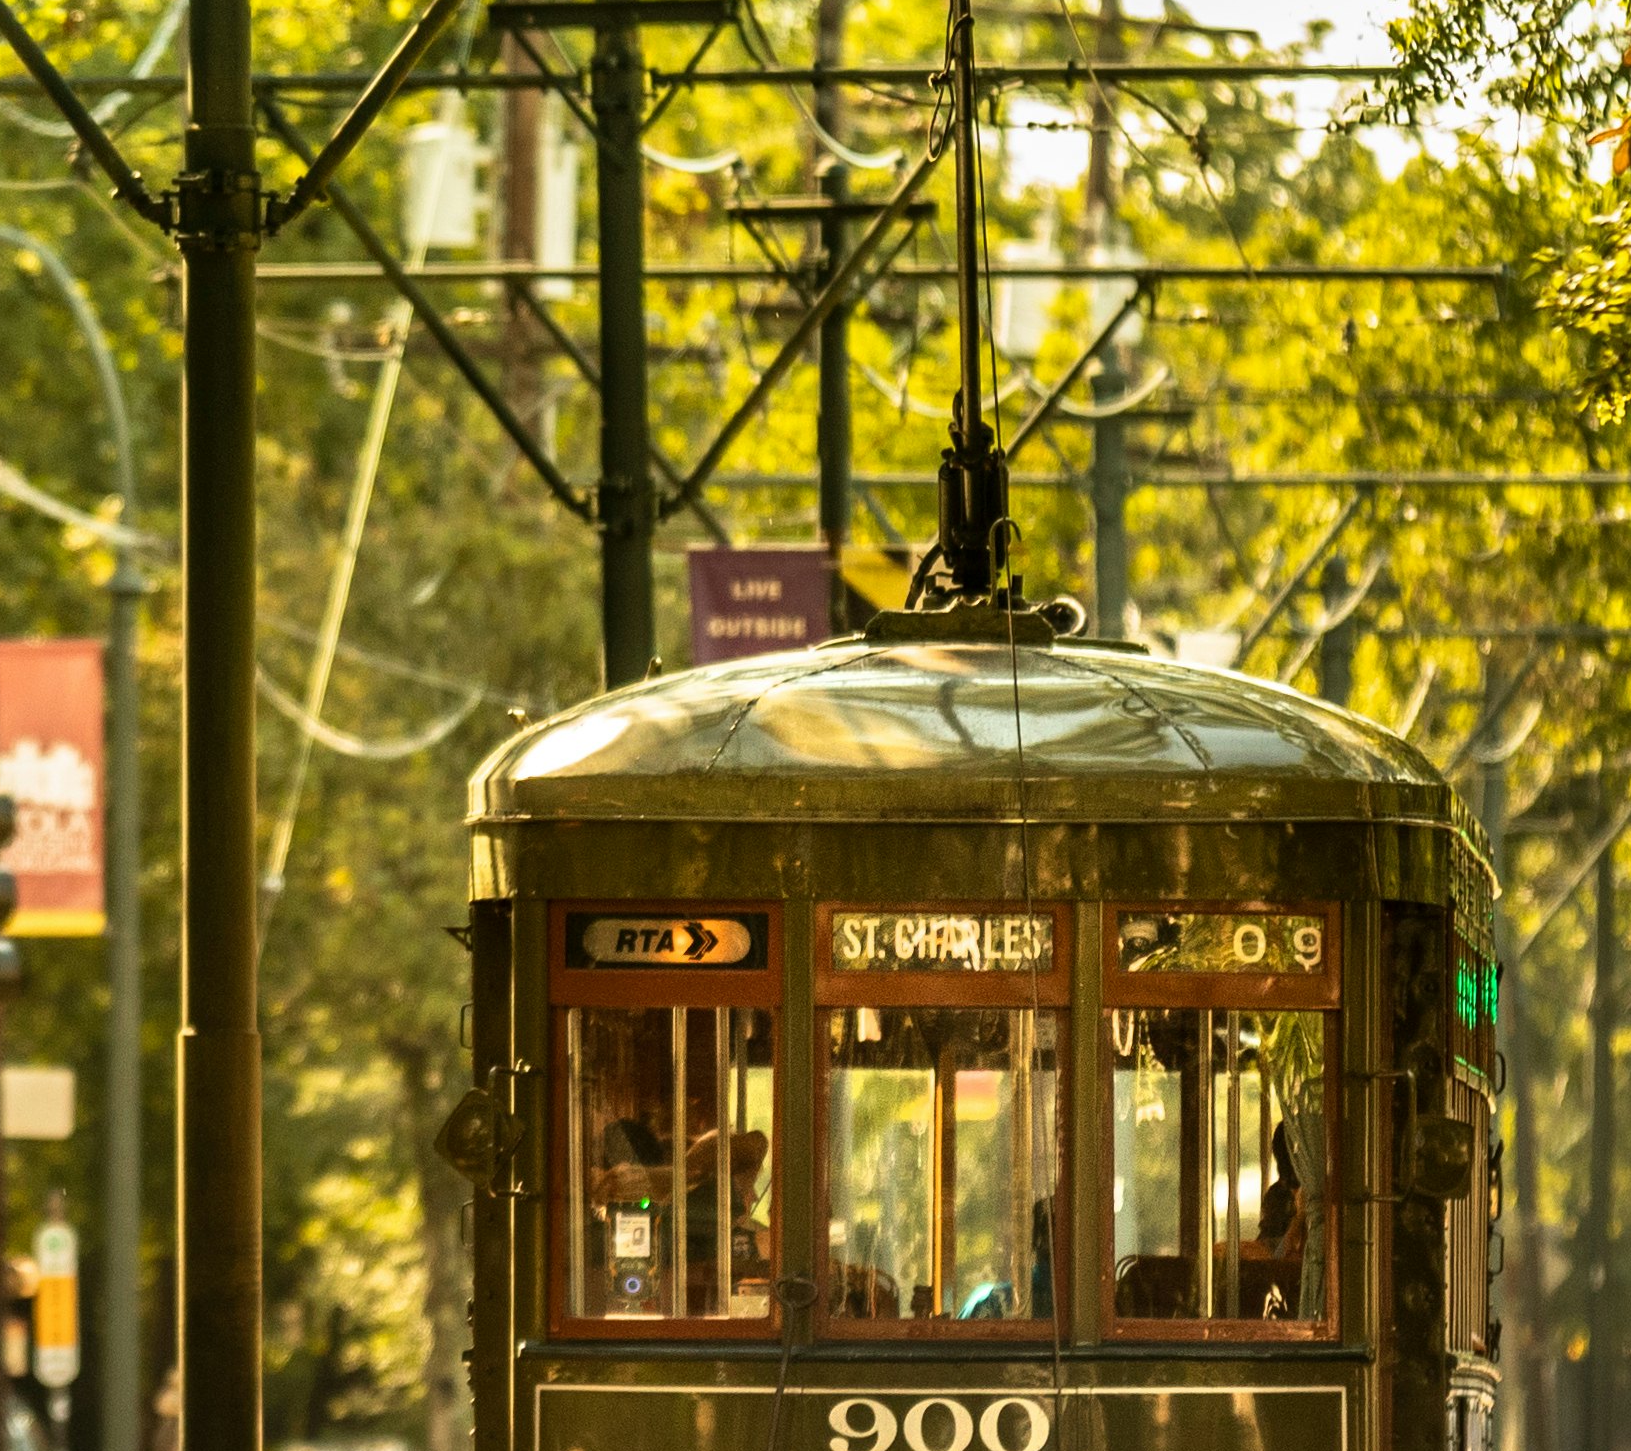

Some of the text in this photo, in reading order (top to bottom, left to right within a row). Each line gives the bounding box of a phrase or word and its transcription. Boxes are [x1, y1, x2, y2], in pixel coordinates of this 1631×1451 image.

[730, 579, 783, 600] LIVE
[707, 616, 807, 639] OUTSIDE
[615, 928, 675, 953] RTA
[842, 918, 1042, 961] ST. CHARLES
